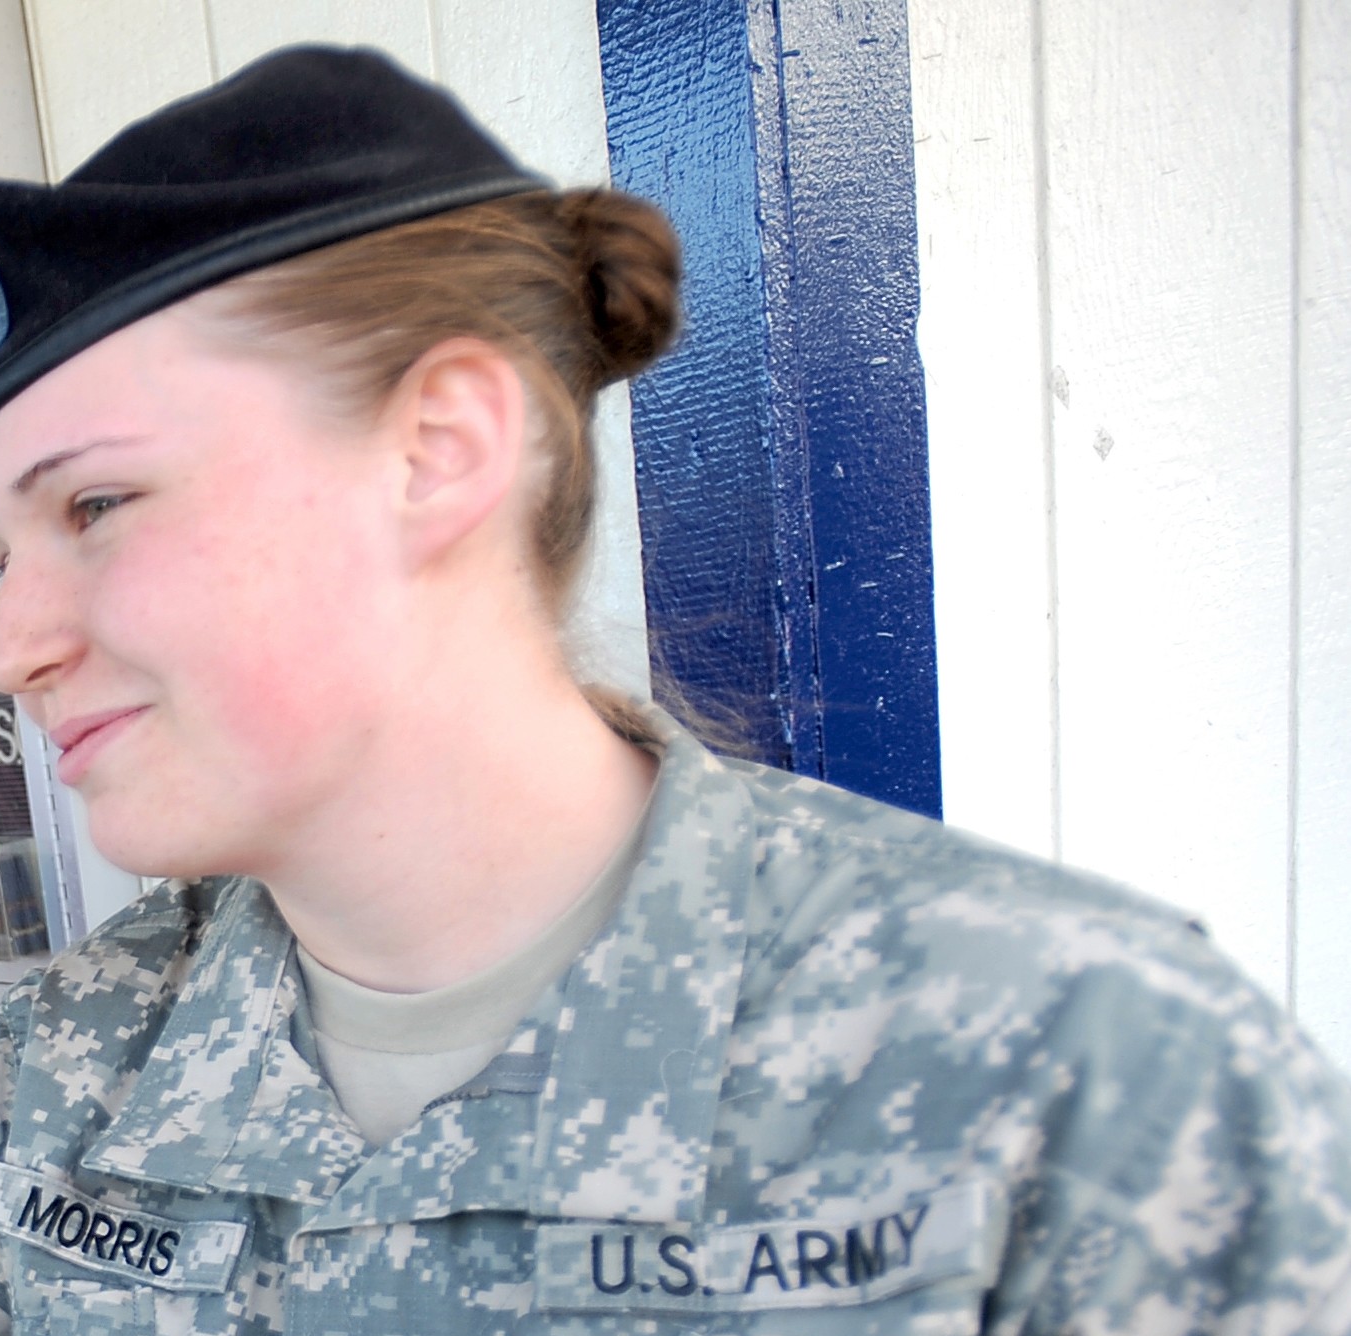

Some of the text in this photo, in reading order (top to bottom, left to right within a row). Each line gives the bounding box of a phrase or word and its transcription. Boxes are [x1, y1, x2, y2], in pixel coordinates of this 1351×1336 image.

[17, 1185, 181, 1277] MORRIS
[591, 1202, 931, 1297] U.S. ARMY
